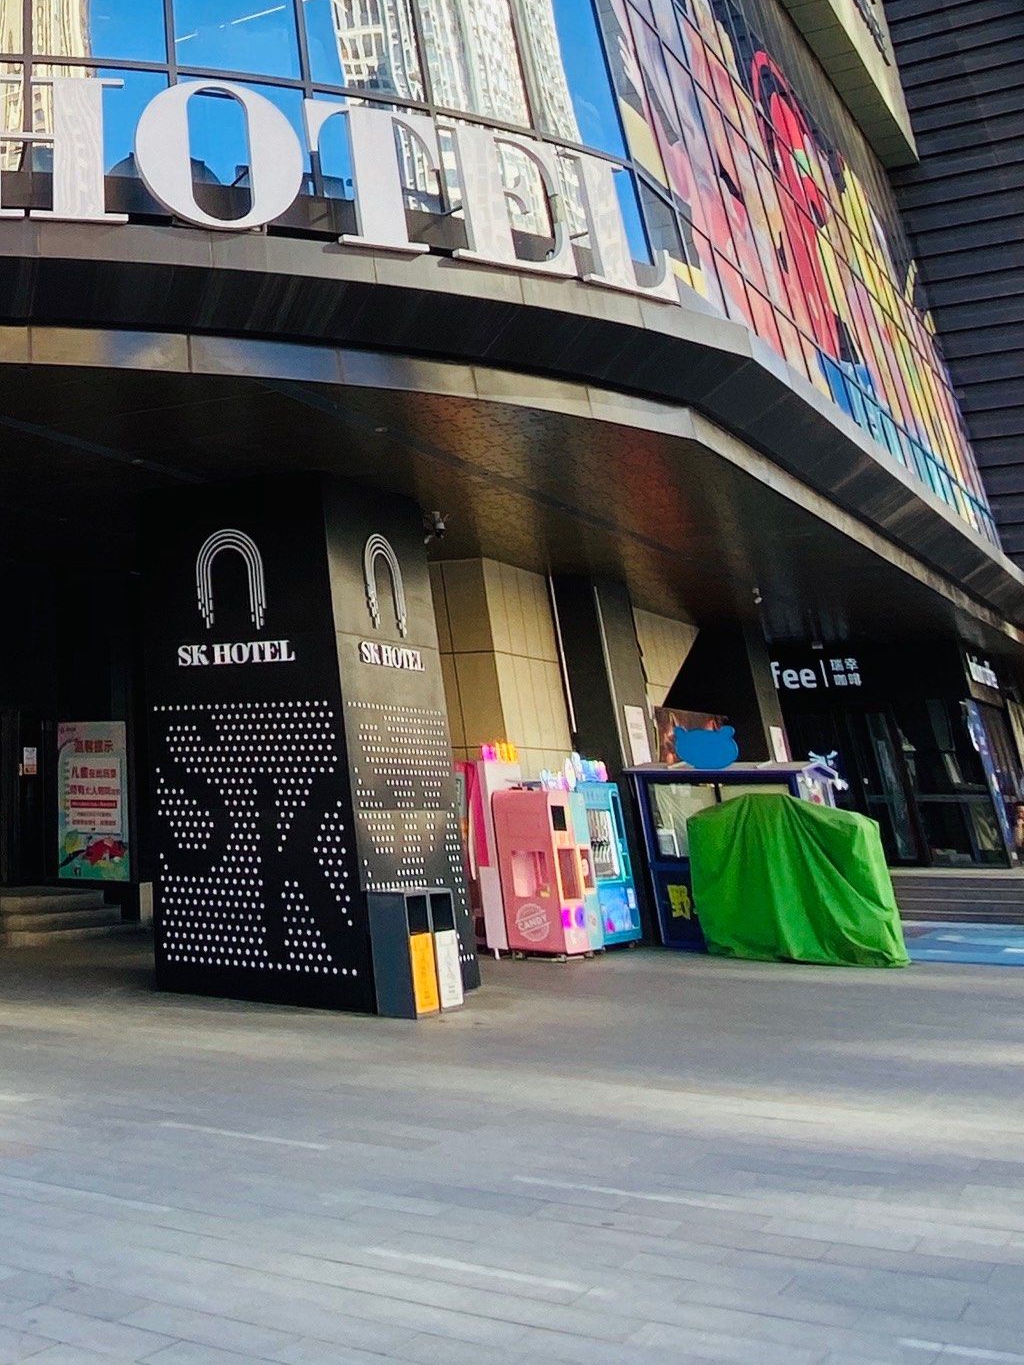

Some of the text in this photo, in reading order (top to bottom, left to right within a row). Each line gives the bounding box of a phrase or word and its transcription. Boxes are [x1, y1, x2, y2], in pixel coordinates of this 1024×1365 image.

[176, 639, 296, 667] SK HOTEL
[360, 640, 426, 673] SK HOTEL
[517, 913, 548, 932] CANDY
